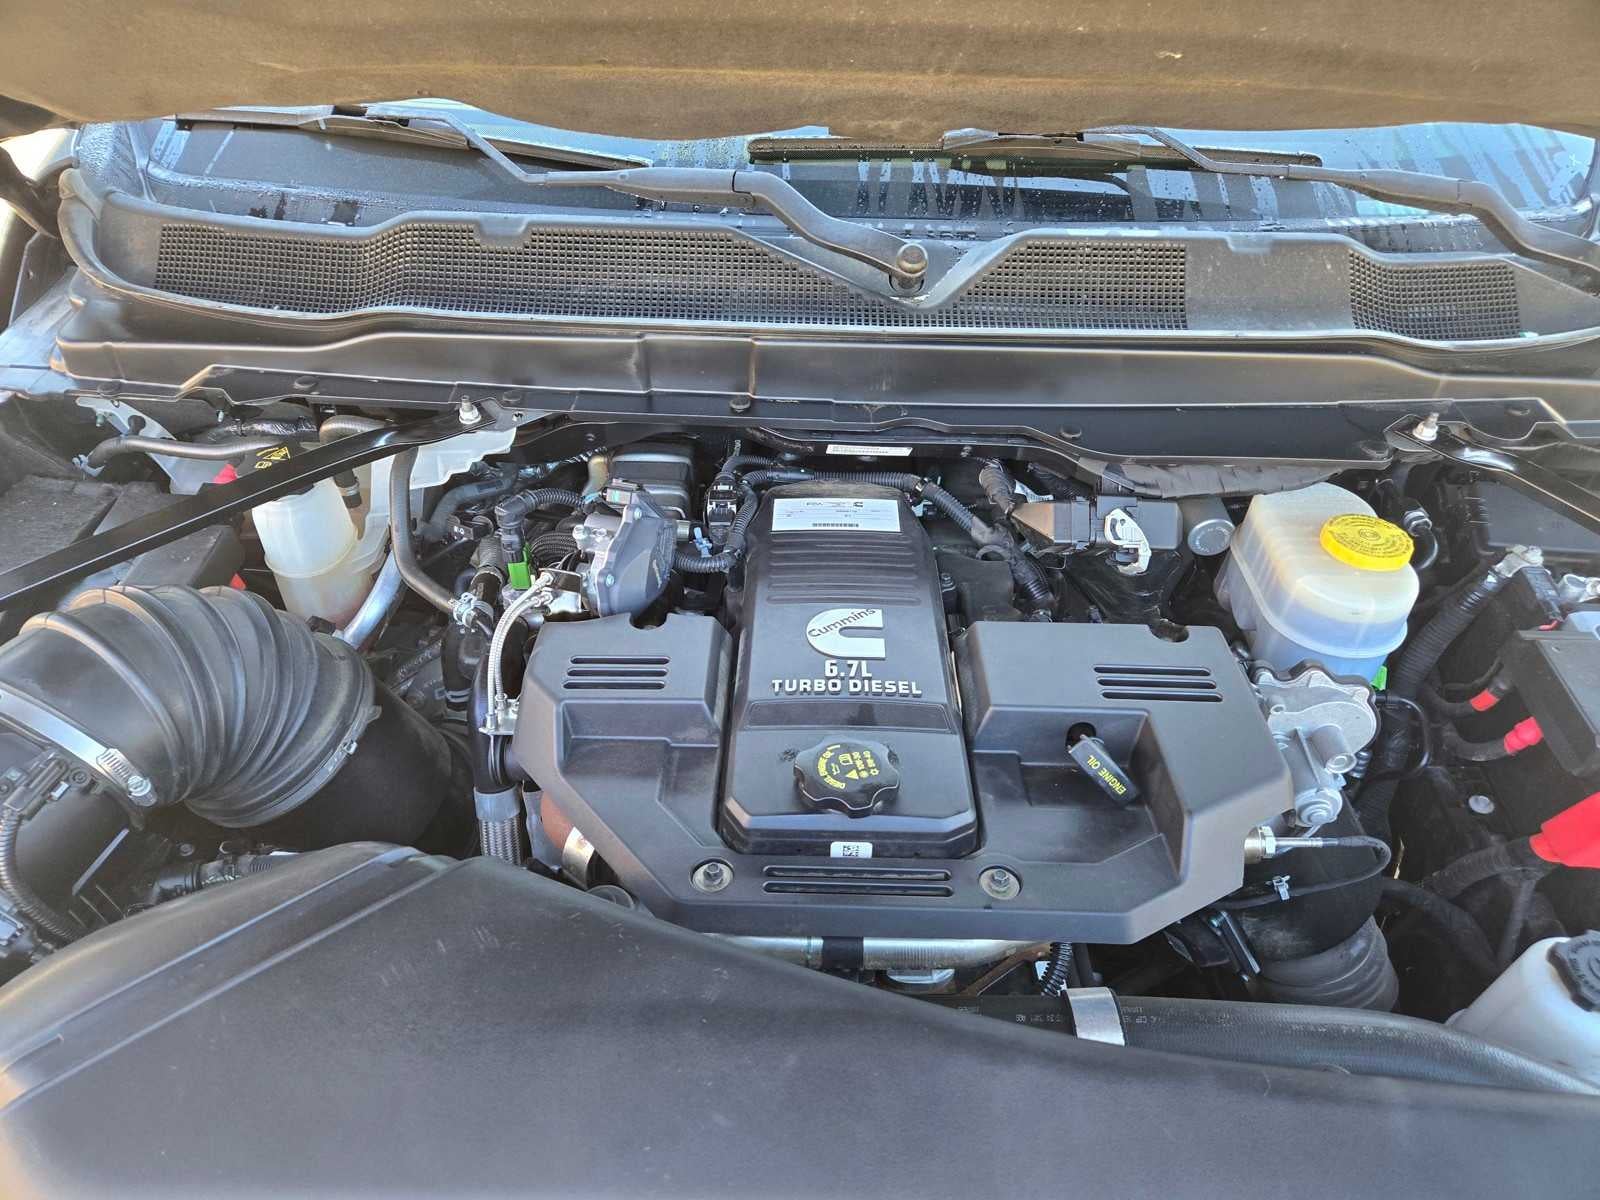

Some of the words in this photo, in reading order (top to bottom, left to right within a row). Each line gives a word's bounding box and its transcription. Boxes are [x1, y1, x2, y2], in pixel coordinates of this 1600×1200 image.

[807, 608, 877, 638] Cummins
[824, 659, 873, 679] 6.7L
[772, 678, 843, 695] TURBO
[849, 679, 923, 697] DIESEL
[1087, 754, 1101, 770] OIL
[1097, 767, 1127, 796] ENGINE
